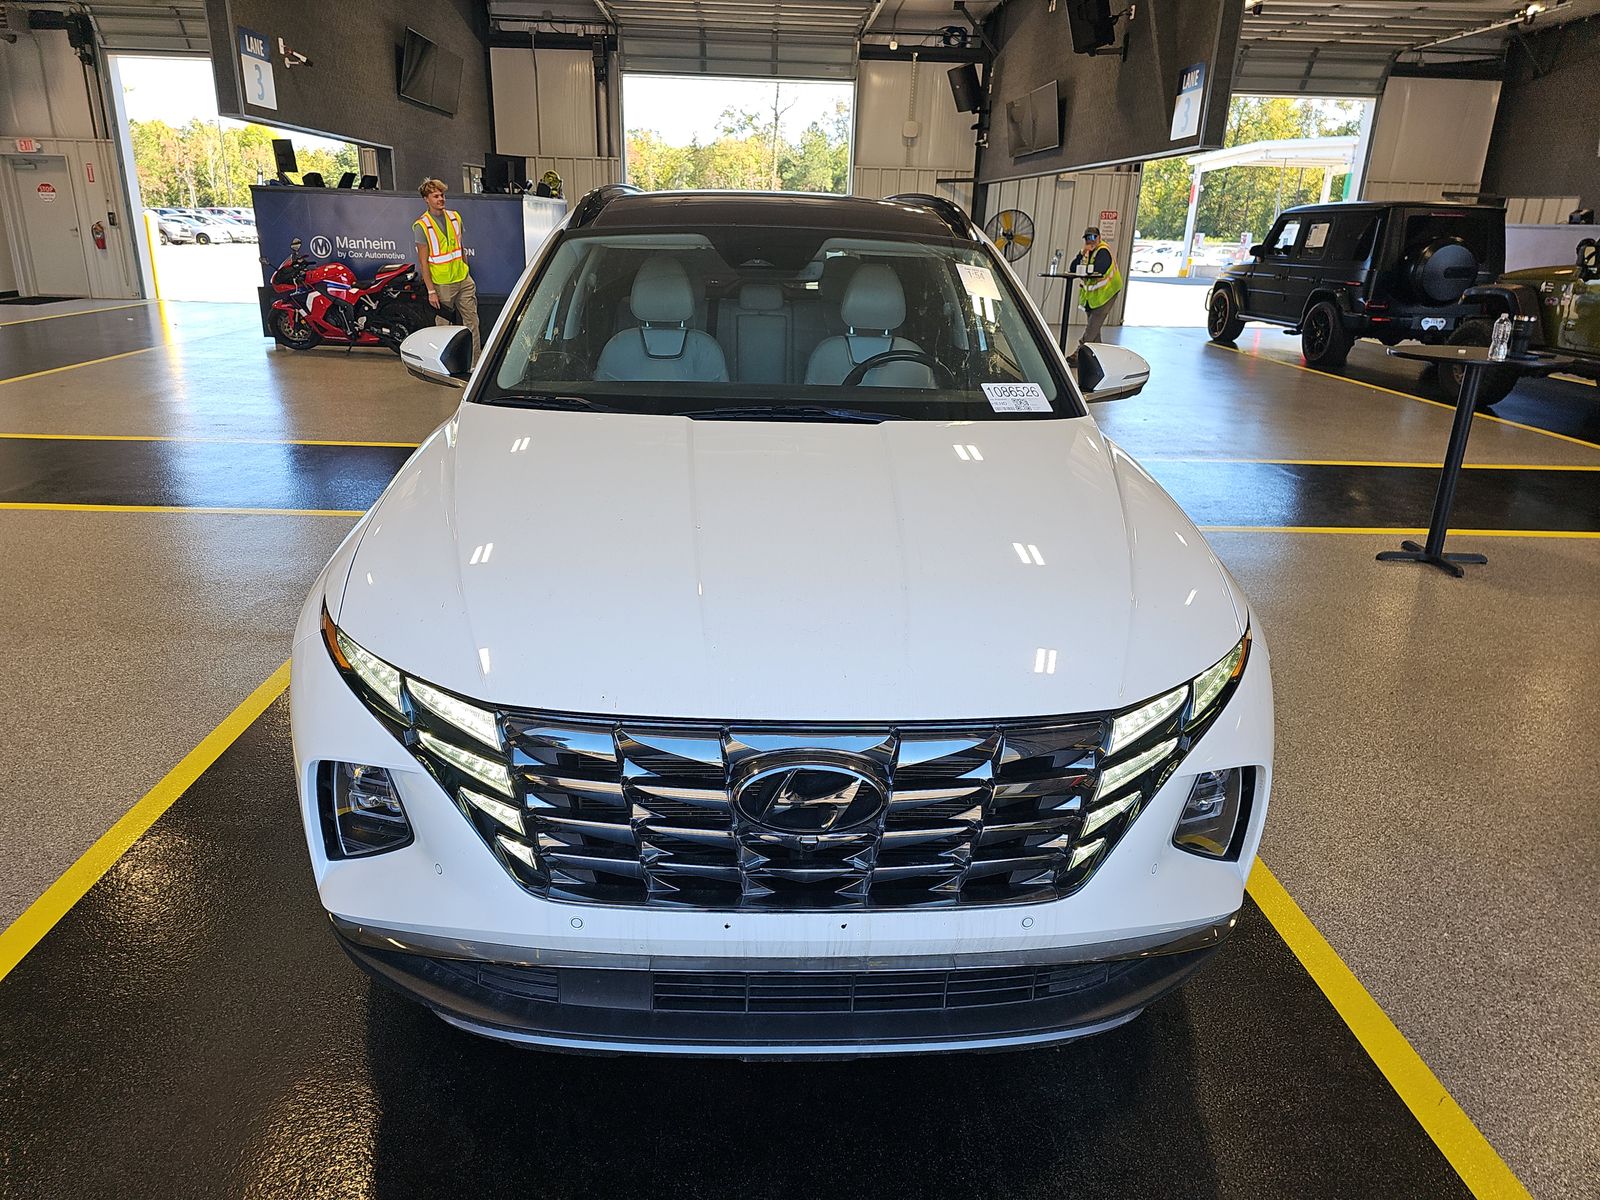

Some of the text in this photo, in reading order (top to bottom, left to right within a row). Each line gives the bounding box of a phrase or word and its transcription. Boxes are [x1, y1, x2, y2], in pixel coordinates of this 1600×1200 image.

[244, 34, 265, 57] LANE
[254, 63, 265, 101] 3
[1182, 69, 1200, 90] LANE
[1180, 96, 1192, 133] 3
[40, 185, 54, 193] STOP
[1101, 211, 1118, 220] STOP
[336, 236, 396, 251] Manheim
[337, 250, 347, 260] by
[348, 250, 364, 259] Cox
[364, 251, 406, 260] Automotive
[987, 386, 1040, 398] 1086526
